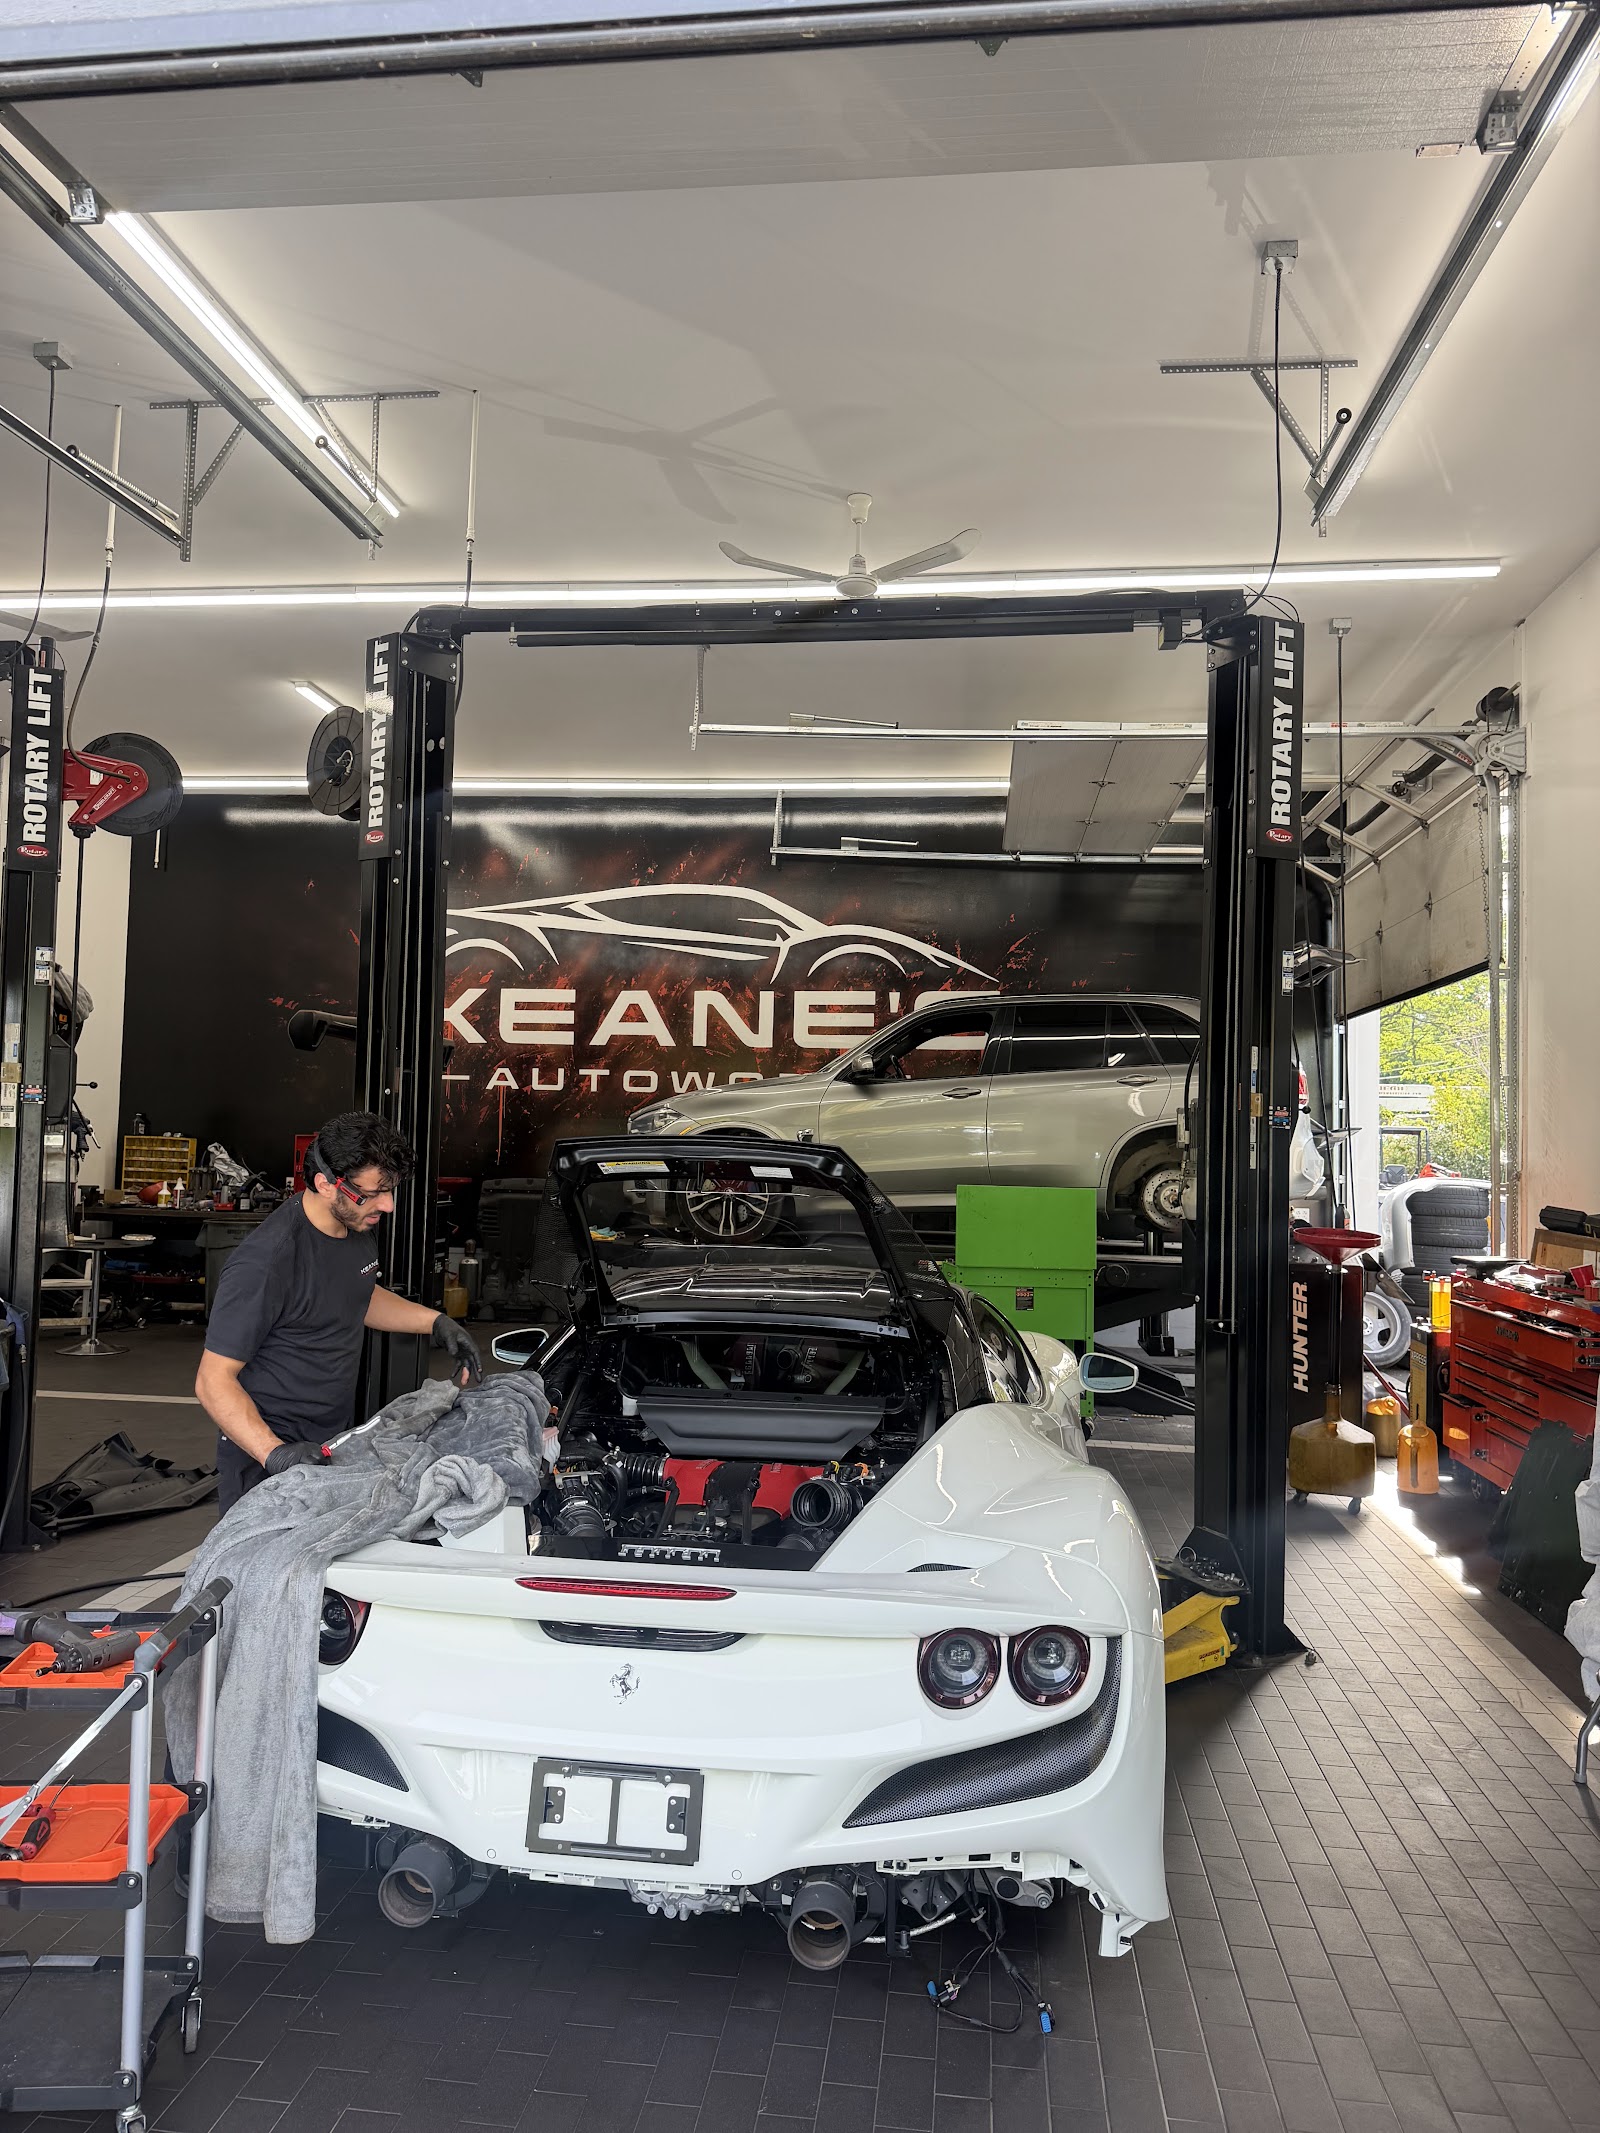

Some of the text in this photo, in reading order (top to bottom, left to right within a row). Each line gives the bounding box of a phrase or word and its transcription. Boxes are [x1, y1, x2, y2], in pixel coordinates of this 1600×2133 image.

[23, 668, 52, 842] ROTARY LIFT
[368, 640, 389, 828] ROTARY LIFT
[1271, 621, 1295, 826] ROTARY LIFT
[1293, 1282, 1308, 1393] HUNTER
[618, 1544, 721, 1563] Ferrari
